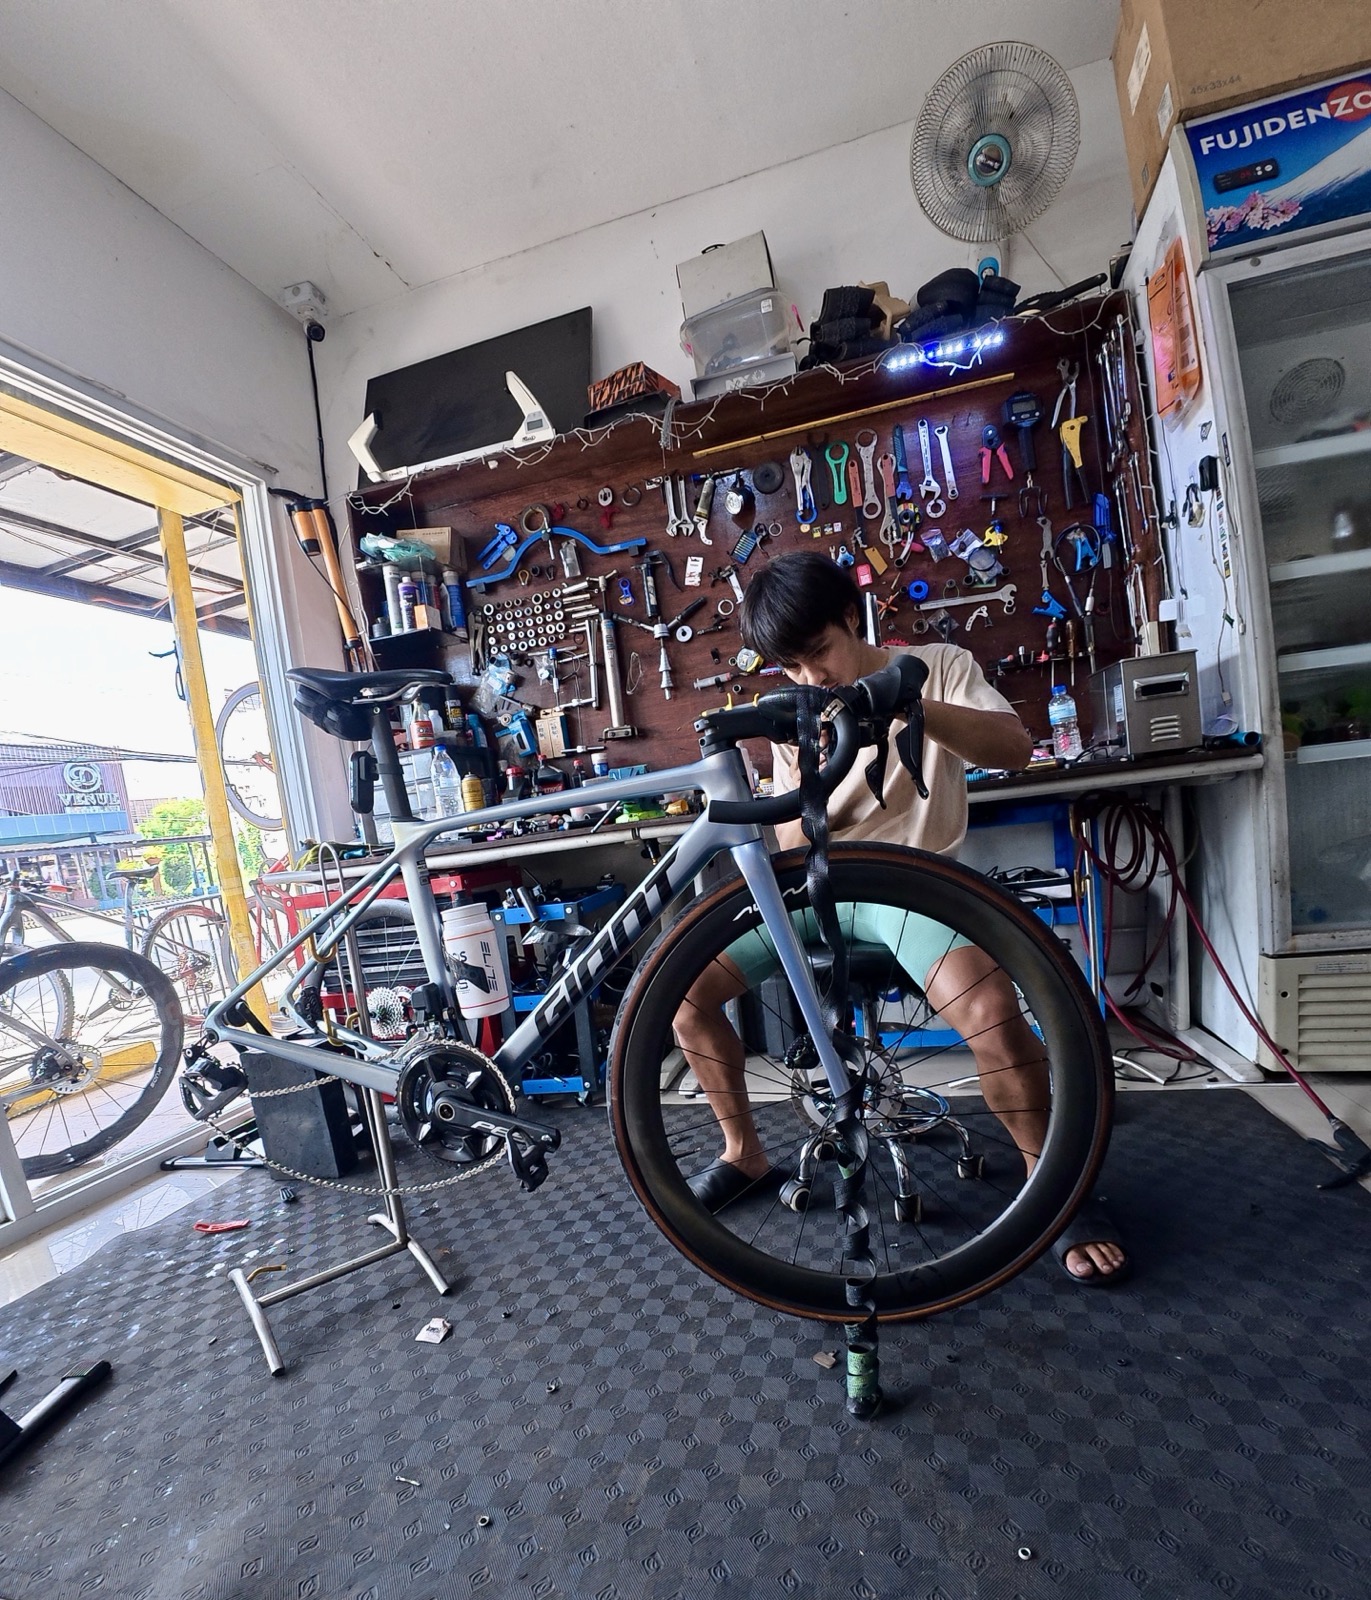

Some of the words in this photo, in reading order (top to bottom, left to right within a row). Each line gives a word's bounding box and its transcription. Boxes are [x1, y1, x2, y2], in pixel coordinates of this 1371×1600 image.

[1190, 75, 1242, 95] 45x33x44
[58, 793, 120, 806] VENUE
[535, 847, 679, 1038] GIANT
